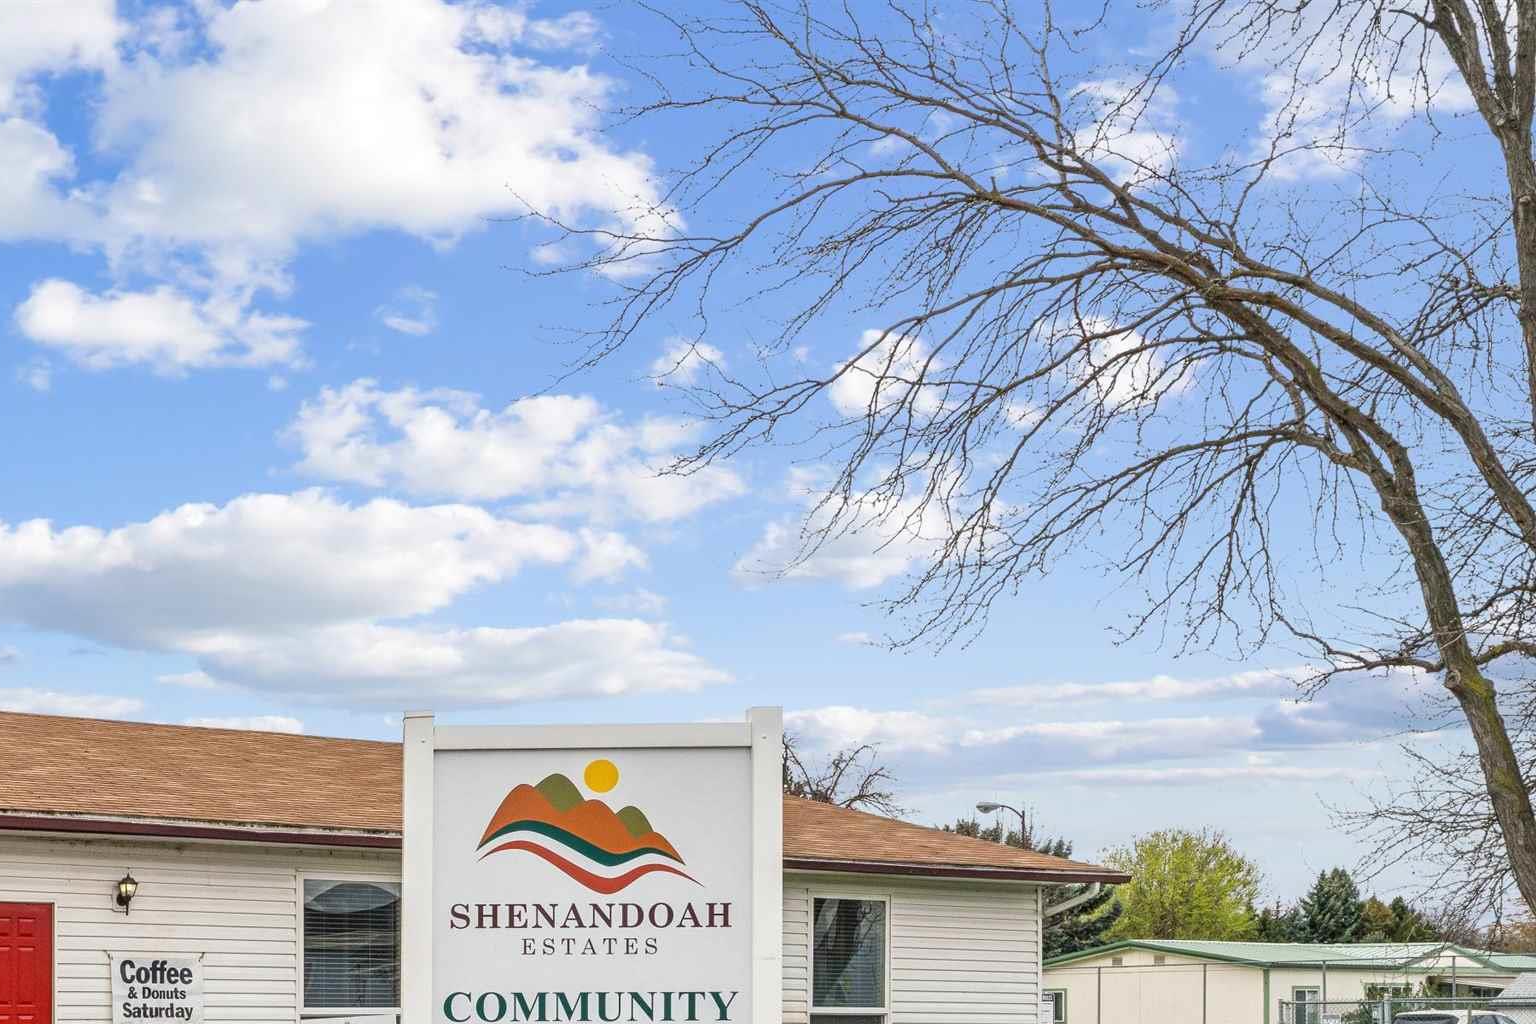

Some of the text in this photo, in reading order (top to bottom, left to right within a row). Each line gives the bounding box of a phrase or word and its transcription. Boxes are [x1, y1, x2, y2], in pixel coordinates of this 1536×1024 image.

[449, 901, 733, 930] SHENANDOAH
[521, 937, 659, 956] ESTATES
[120, 960, 193, 985] Coffee
[127, 986, 186, 1000] & Donuts
[122, 1002, 193, 1021] Saturday
[443, 990, 739, 1023] COMMUNITY
